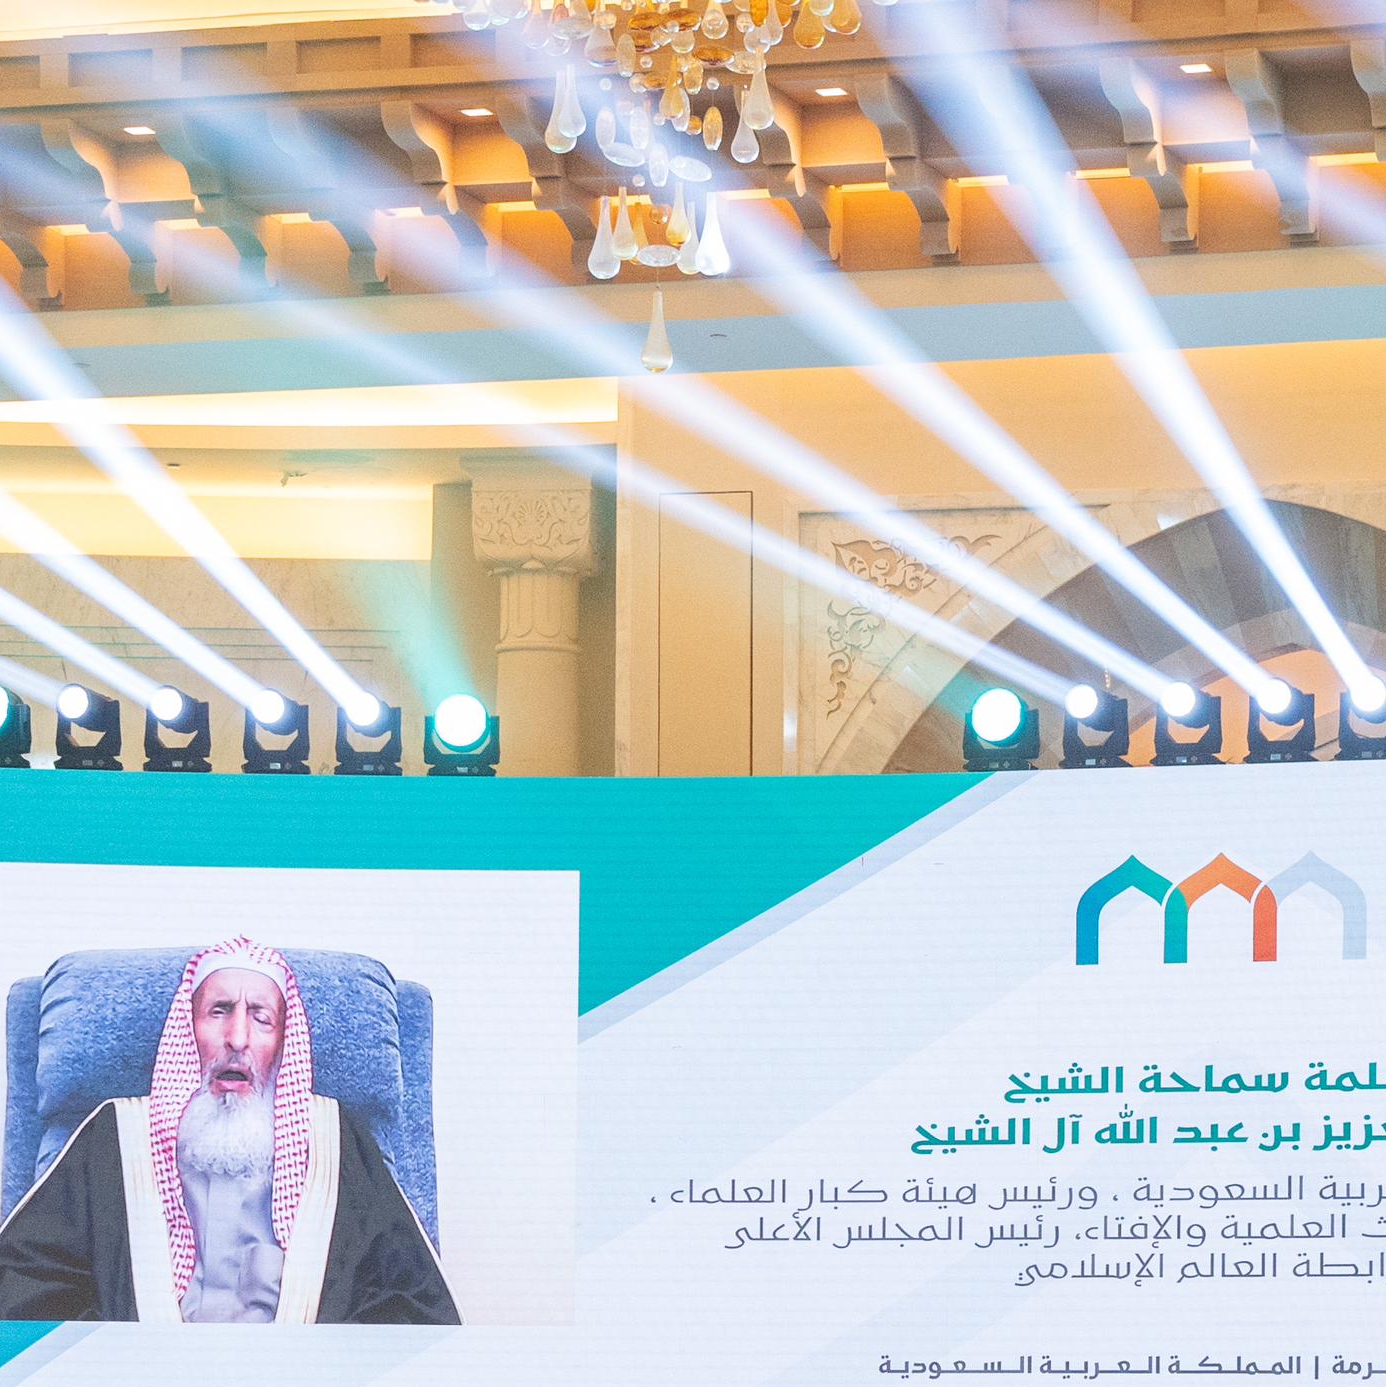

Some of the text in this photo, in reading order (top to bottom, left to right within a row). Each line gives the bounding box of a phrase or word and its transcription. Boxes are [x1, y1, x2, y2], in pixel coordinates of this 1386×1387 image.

[1004, 1062, 1124, 1104] الشيخ
[1138, 1064, 1289, 1094] سماحة
[910, 1114, 1031, 1155] الشيخ
[1042, 1114, 1080, 1154] آل
[1094, 1103, 1158, 1144] الله
[1172, 1122, 1248, 1152] عبد
[1258, 1122, 1301, 1152] بن
[670, 1178, 786, 1204] العلماء
[806, 1178, 888, 1212] كبار
[902, 1177, 977, 1210] هيئة
[988, 1176, 1098, 1211] ورئيس
[1133, 1175, 1304, 1209] السعودية
[724, 1210, 821, 1250] الأعلى
[832, 1216, 963, 1249] المجلس
[974, 1214, 1060, 1249] رئيس
[1220, 1213, 1346, 1246] العلمية
[1014, 1253, 1164, 1287] الإسلامي
[1176, 1252, 1277, 1284] العالم
[878, 1354, 1032, 1380] السعودية
[1039, 1355, 1161, 1380] العربية
[1167, 1355, 1301, 1376] المملكة
